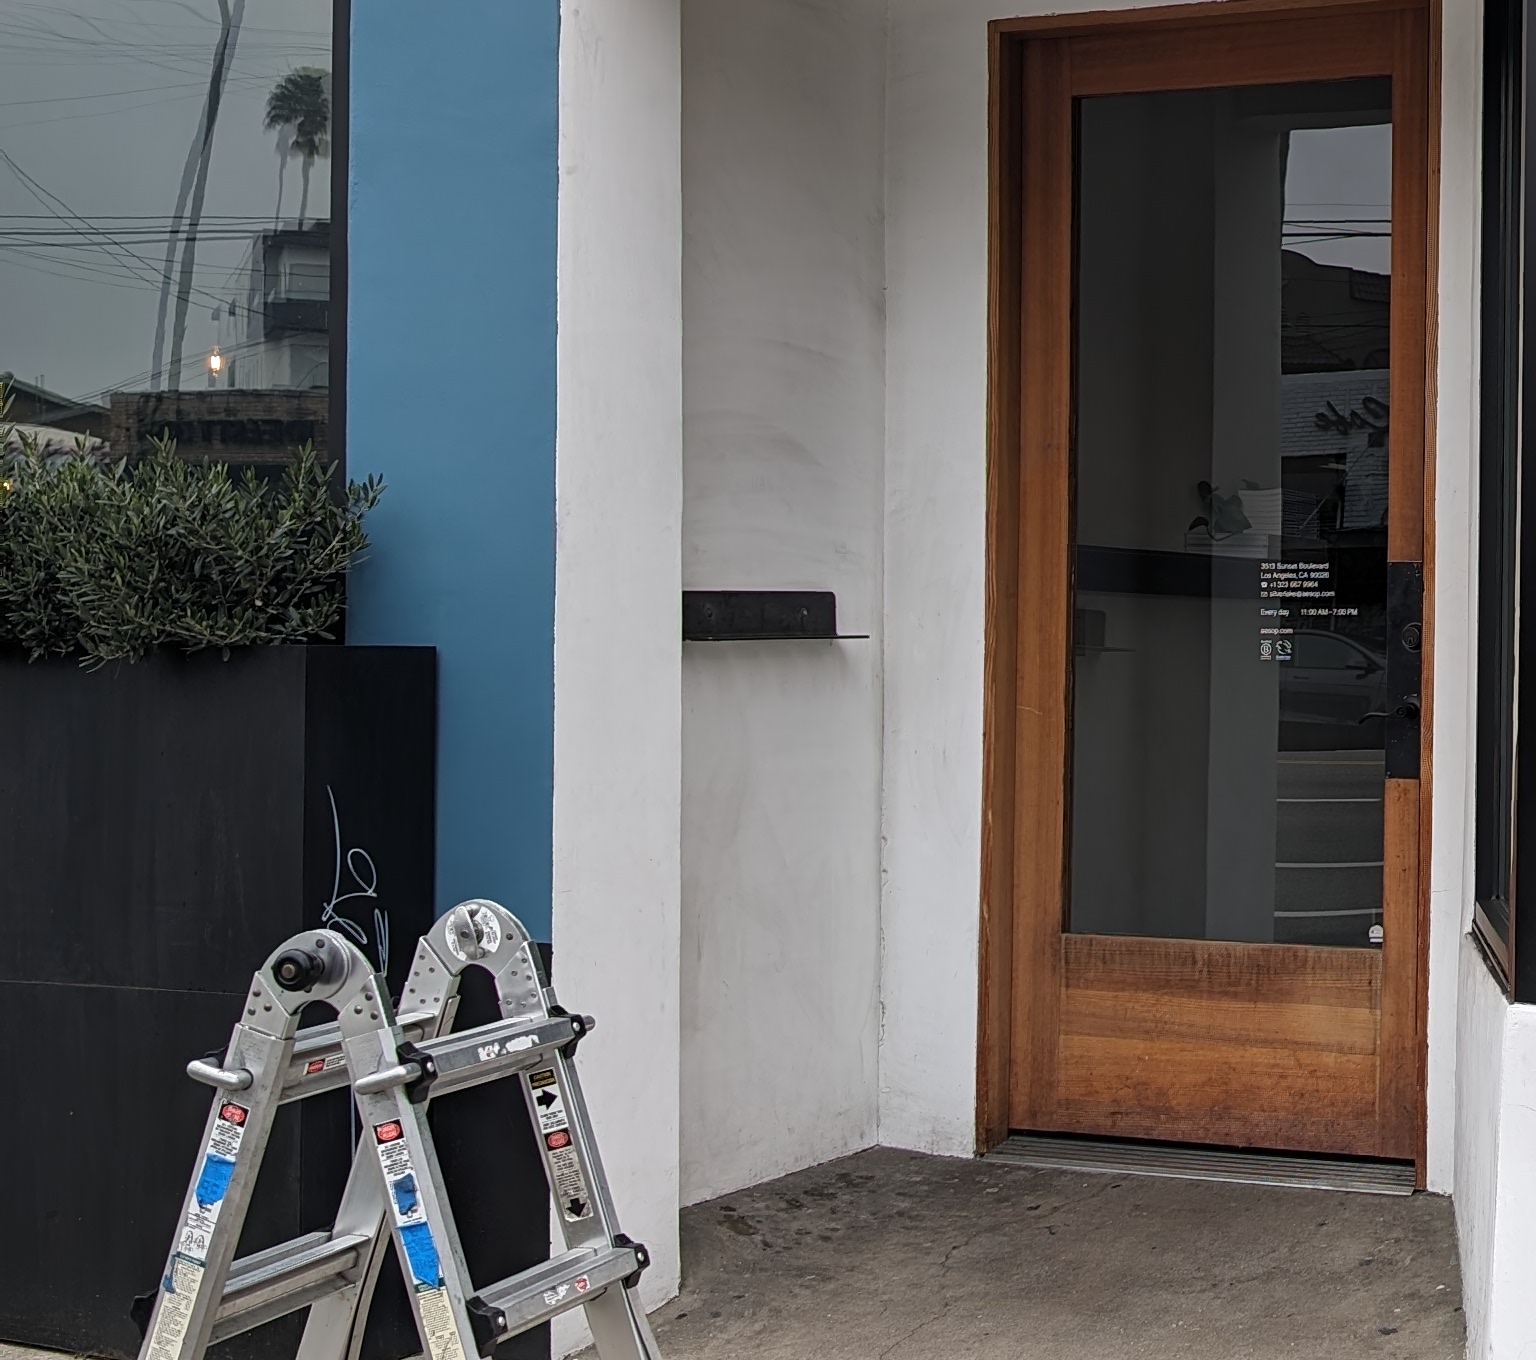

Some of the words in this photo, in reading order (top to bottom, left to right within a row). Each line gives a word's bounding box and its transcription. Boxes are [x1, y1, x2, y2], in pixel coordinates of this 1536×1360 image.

[1260, 562, 1276, 570] 3513
[1299, 561, 1329, 570] Boulevard
[1260, 571, 1272, 579] Los
[1298, 571, 1308, 579] CA
[1260, 608, 1277, 617] Every
[1278, 608, 1290, 617] day
[1347, 608, 1358, 616] PM
